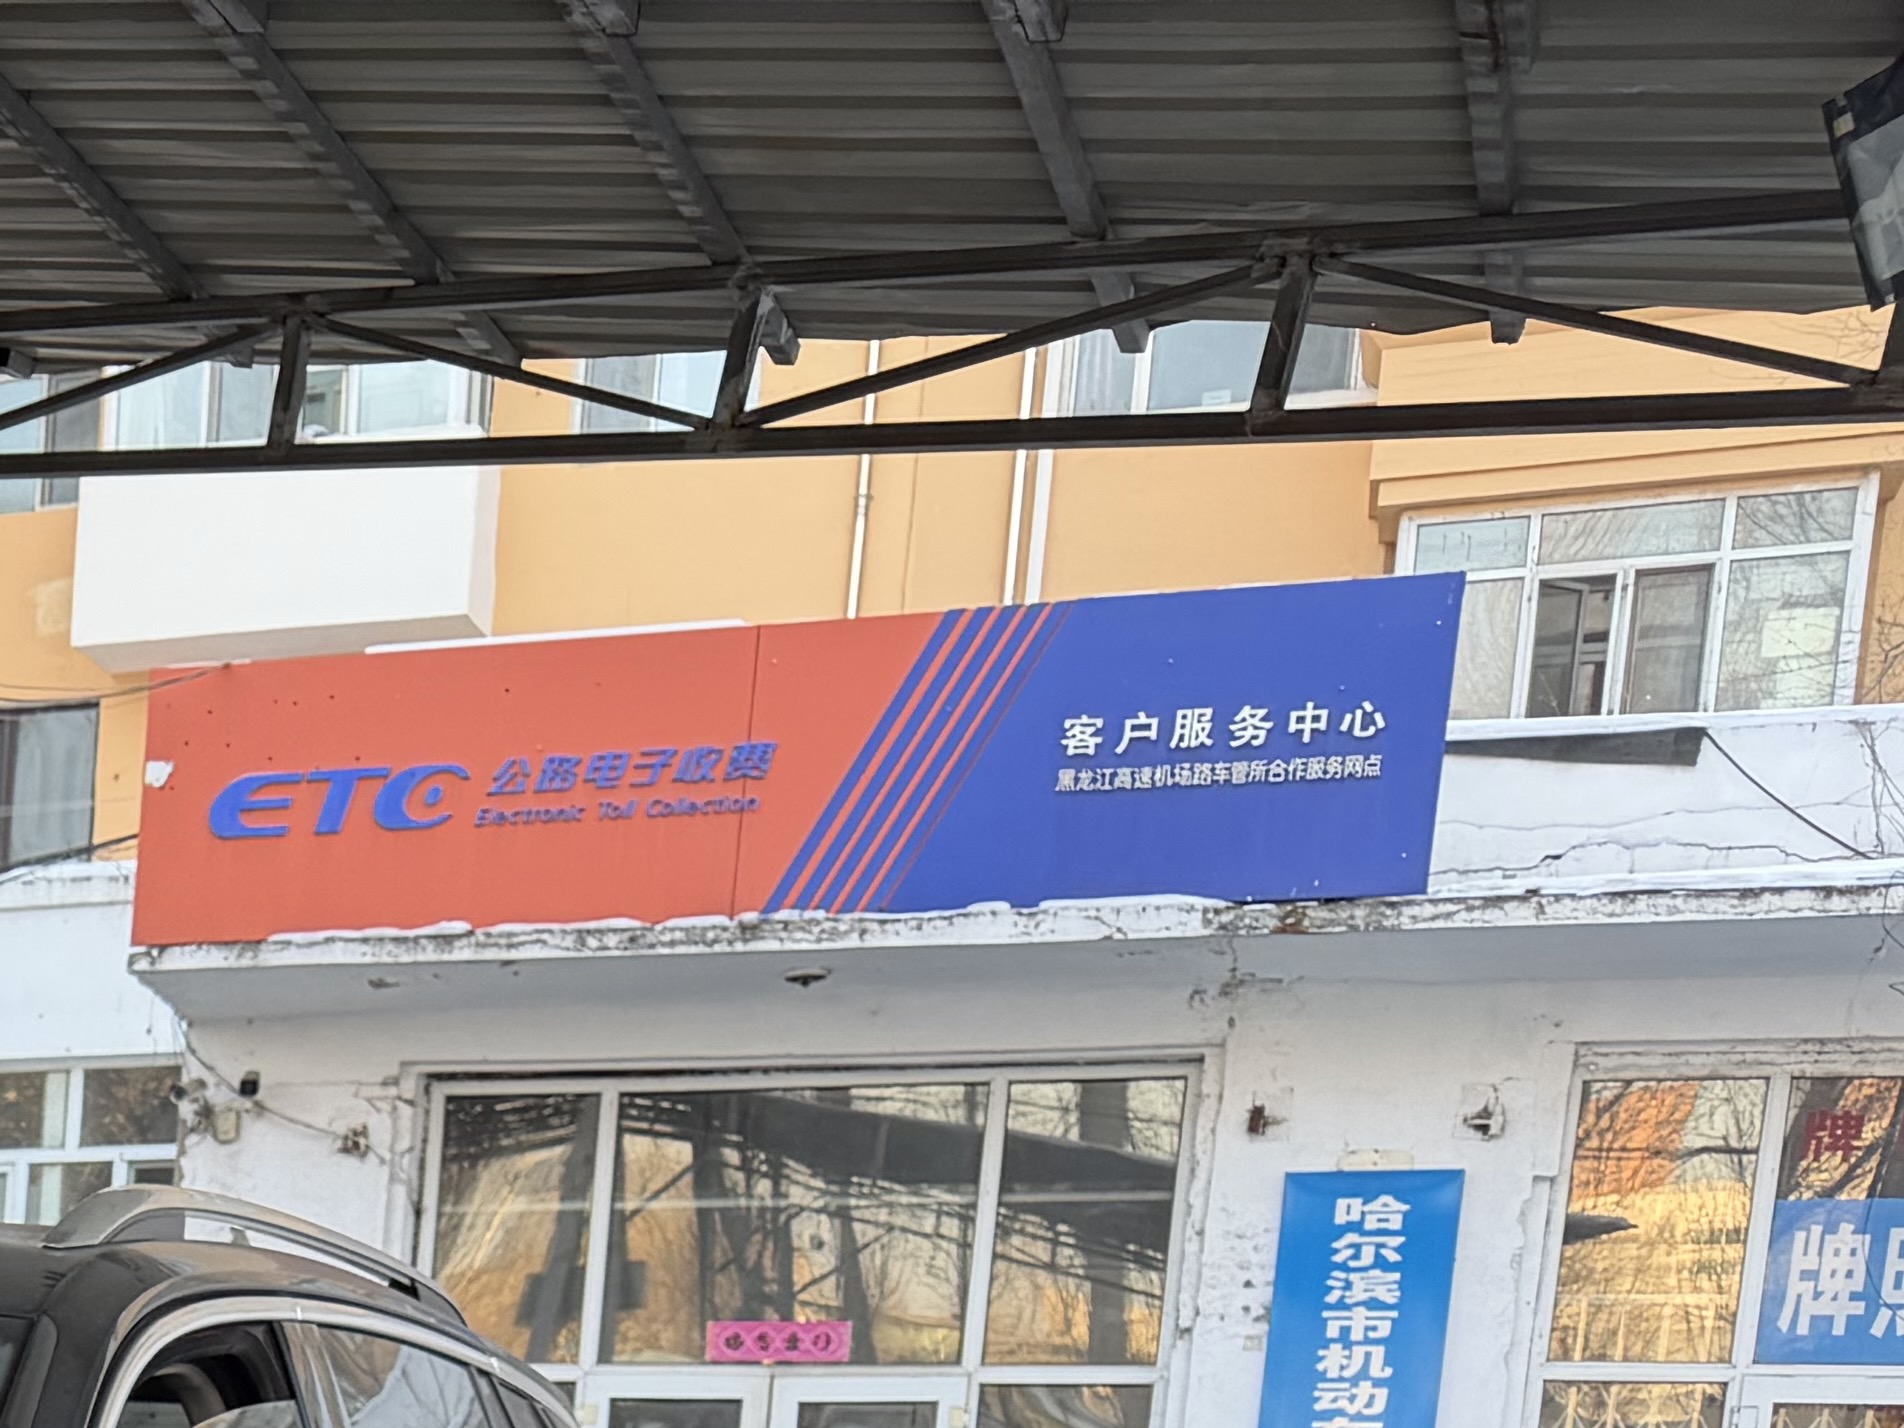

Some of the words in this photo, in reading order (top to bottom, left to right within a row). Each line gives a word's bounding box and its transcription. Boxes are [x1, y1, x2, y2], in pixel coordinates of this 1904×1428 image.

[1060, 701, 1386, 756] 客户服务中心
[487, 743, 777, 796] 公路电子收费
[1055, 754, 1383, 792] 黑龙江高速机场路车管所合作服务网点
[208, 764, 471, 839] ETC
[474, 805, 586, 828] Electronic
[598, 800, 638, 821] Toll
[646, 795, 760, 818] Collection
